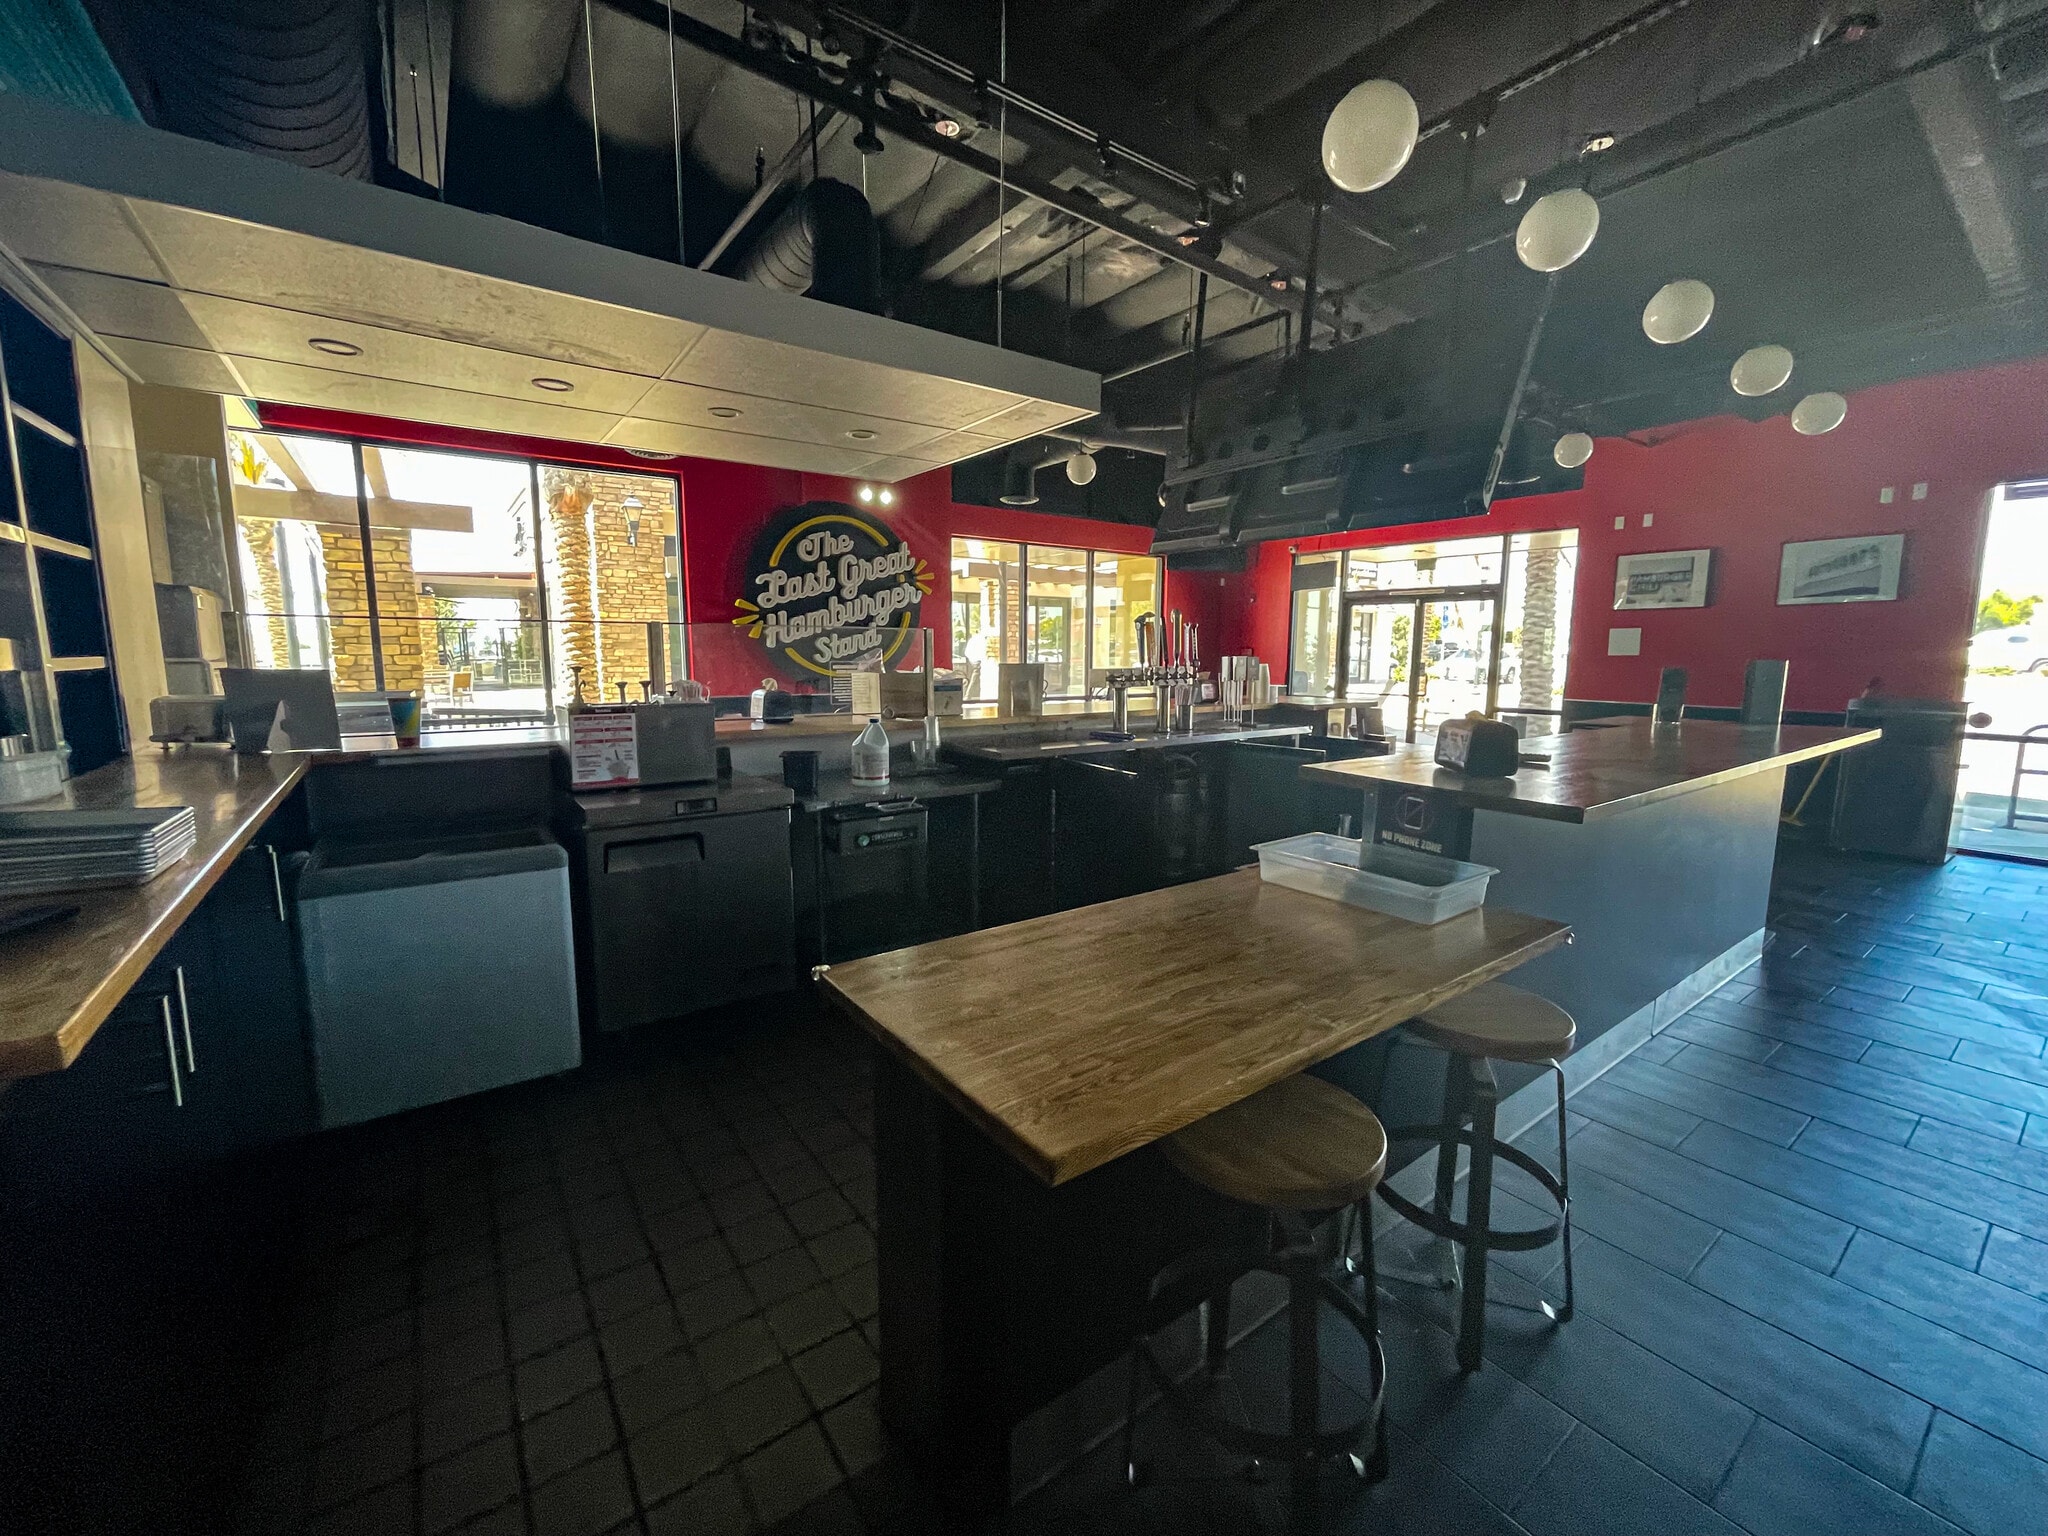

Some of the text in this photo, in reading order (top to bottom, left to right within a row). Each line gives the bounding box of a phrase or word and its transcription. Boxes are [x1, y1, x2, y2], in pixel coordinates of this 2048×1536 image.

[797, 531, 854, 562] The
[755, 541, 915, 608] Last Great
[765, 583, 922, 648] Hamburger
[812, 622, 882, 663] Stand
[1381, 830, 1443, 854] NO PHONE ZONE
